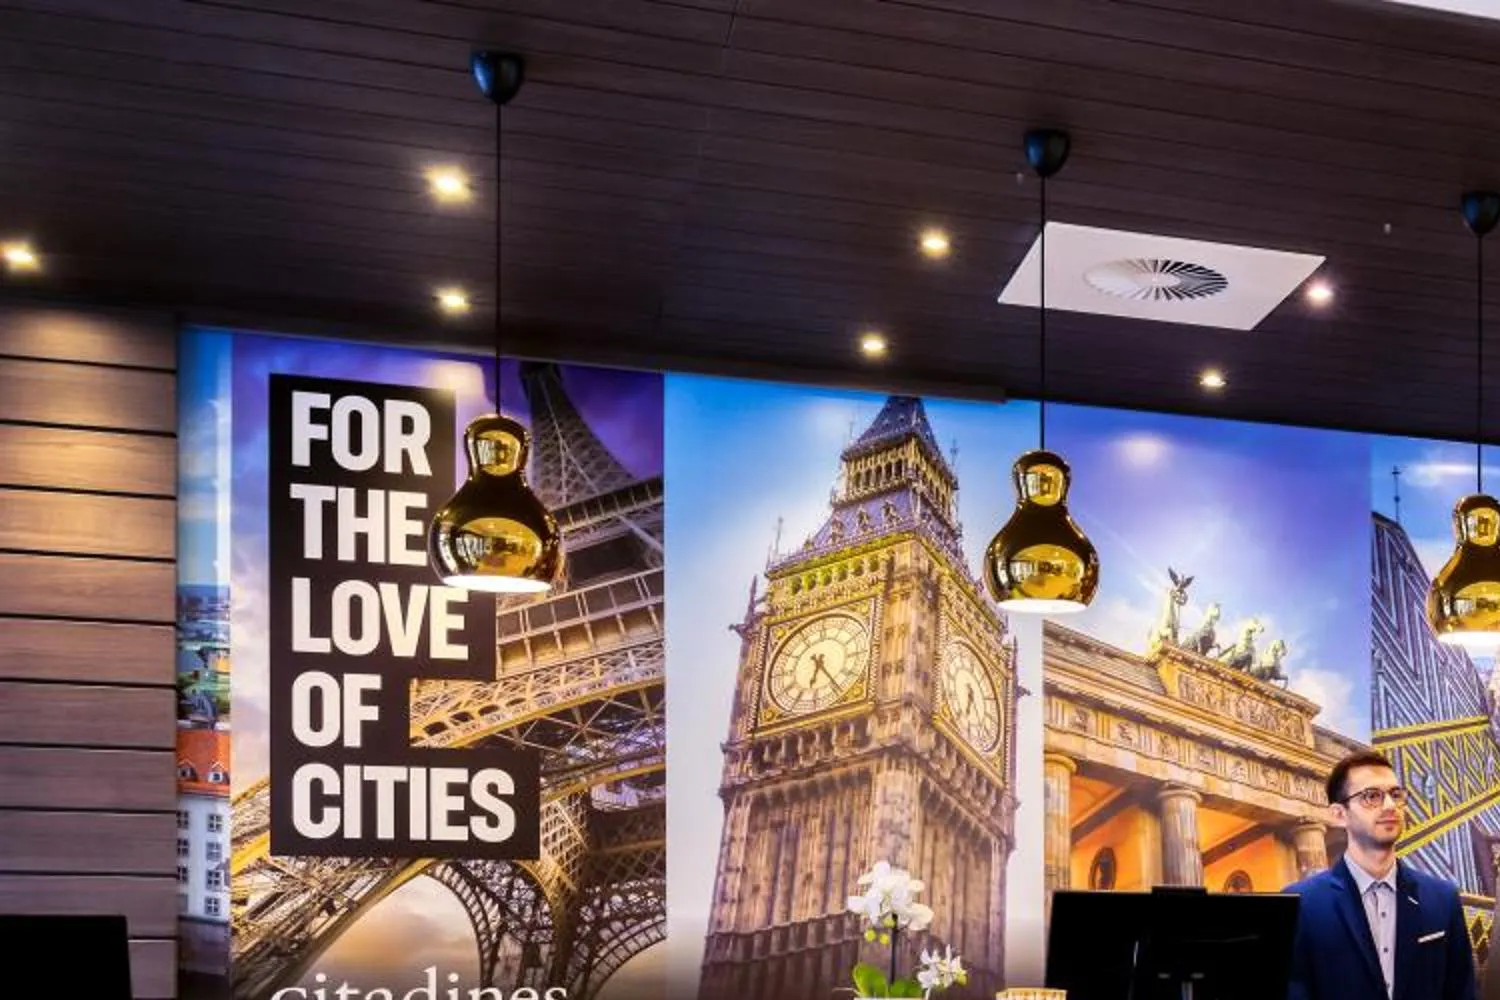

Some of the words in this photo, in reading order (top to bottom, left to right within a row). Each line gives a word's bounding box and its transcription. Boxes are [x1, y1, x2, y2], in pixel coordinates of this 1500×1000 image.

[291, 390, 431, 477] FOR
[290, 482, 428, 567] THE
[291, 577, 469, 661] LOVE
[291, 671, 382, 748] OF
[291, 763, 517, 843] CITIES
